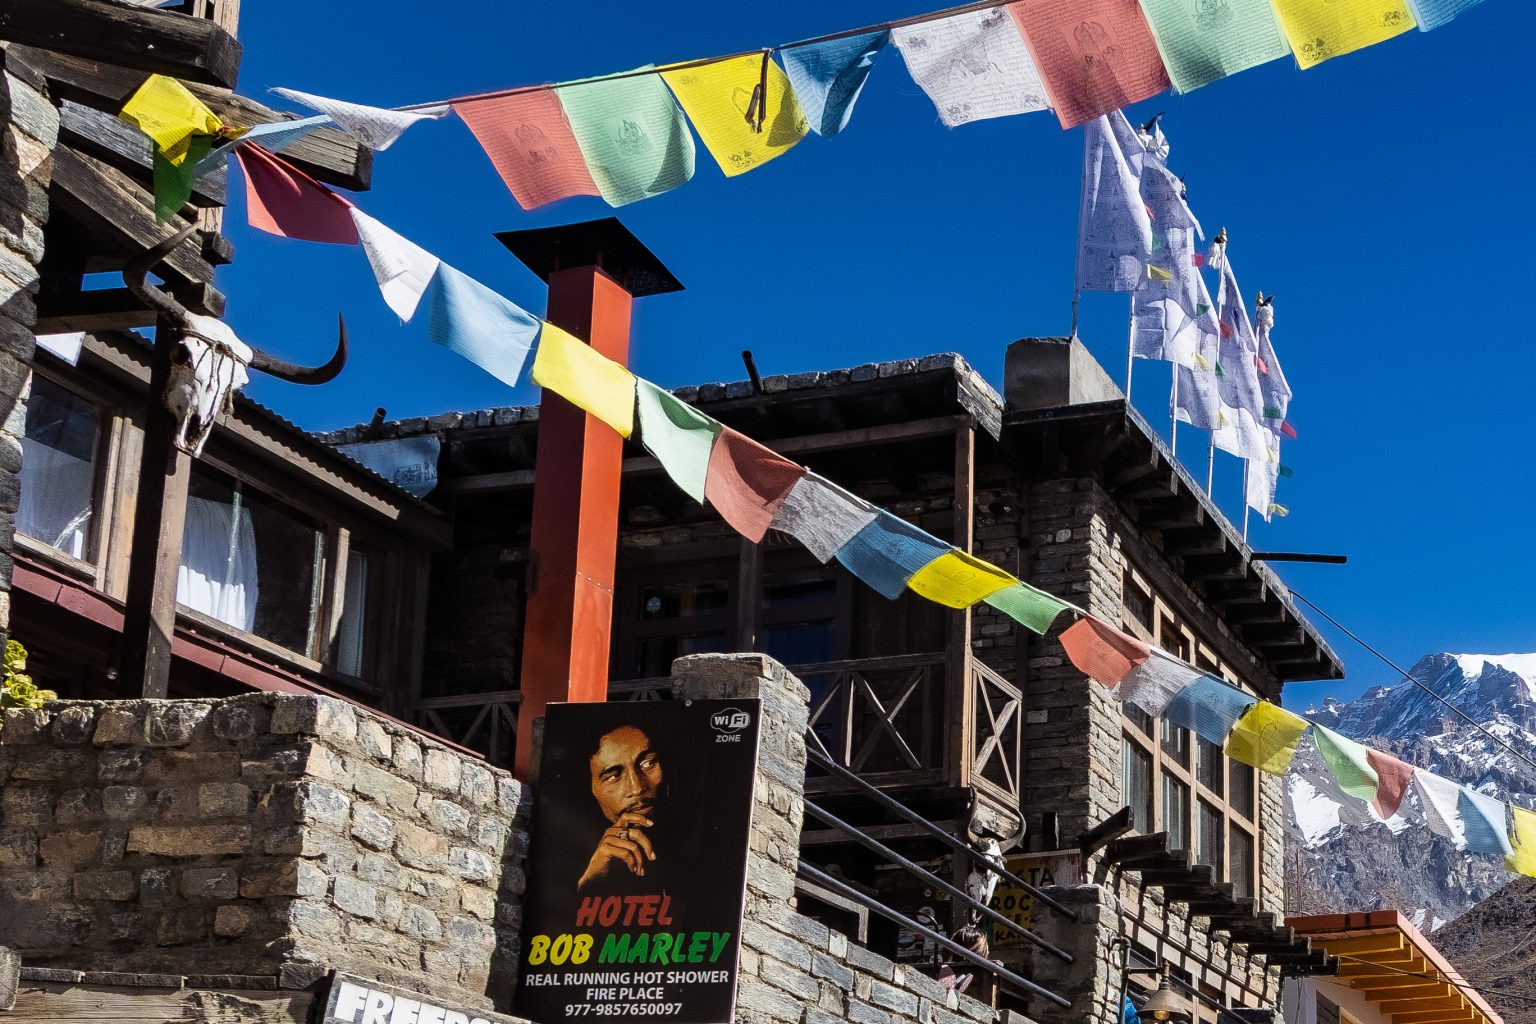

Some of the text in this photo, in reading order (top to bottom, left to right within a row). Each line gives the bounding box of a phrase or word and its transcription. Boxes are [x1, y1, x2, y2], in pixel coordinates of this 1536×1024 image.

[576, 895, 673, 927] HOTEL
[528, 932, 731, 966] BOB MARLEY
[526, 970, 729, 986] REAL RUNNING HOT SHOWER
[586, 987, 664, 1000] FIRE PLACE
[565, 1003, 682, 1016] 977-9857650097
